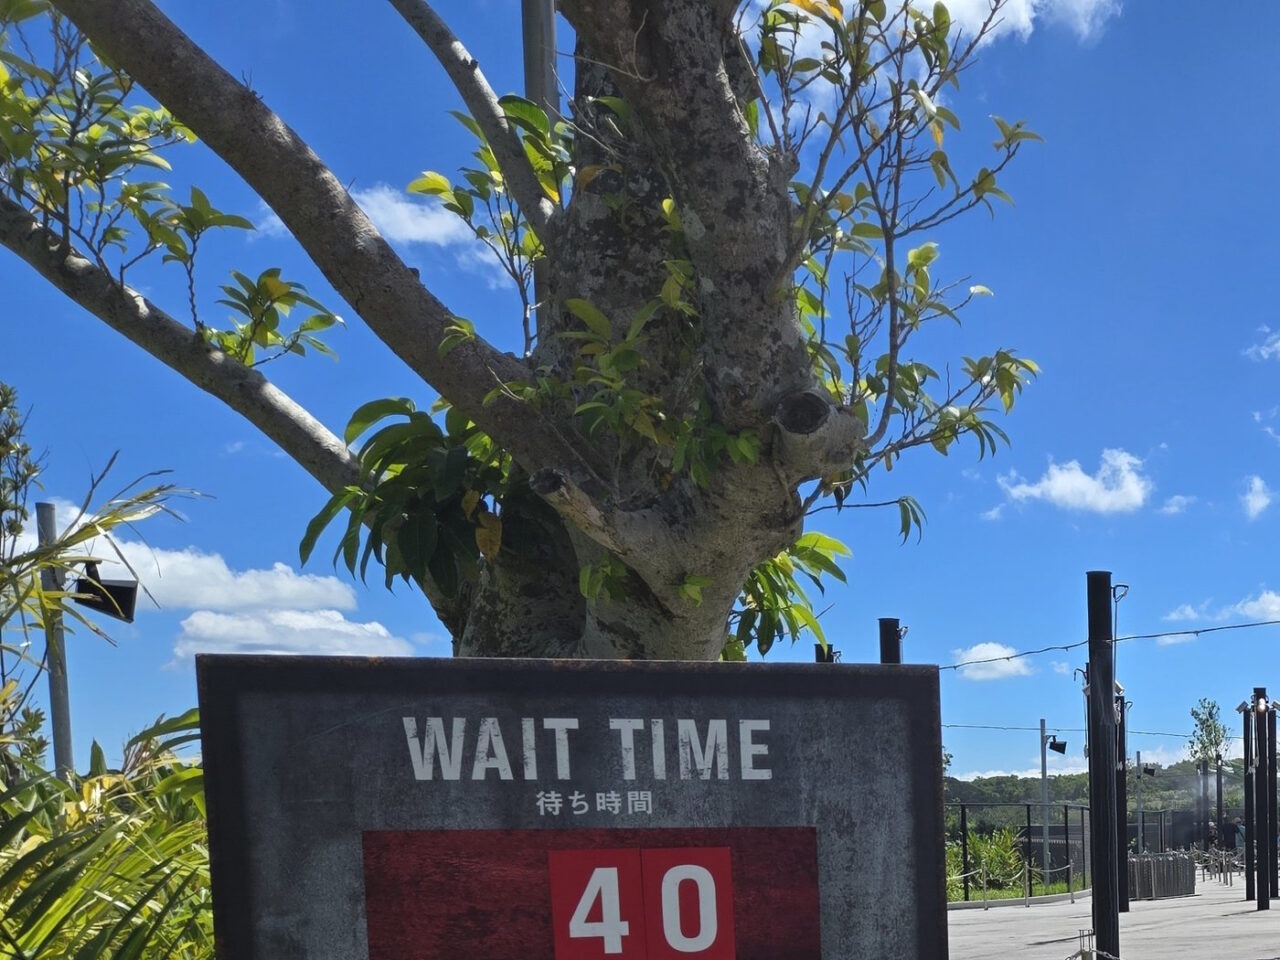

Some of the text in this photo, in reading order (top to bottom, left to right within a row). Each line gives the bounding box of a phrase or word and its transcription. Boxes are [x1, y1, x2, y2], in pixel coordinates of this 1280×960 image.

[403, 716, 773, 781] WAIT TIME
[536, 790, 653, 816] 待ち時間
[568, 863, 718, 955] 40
